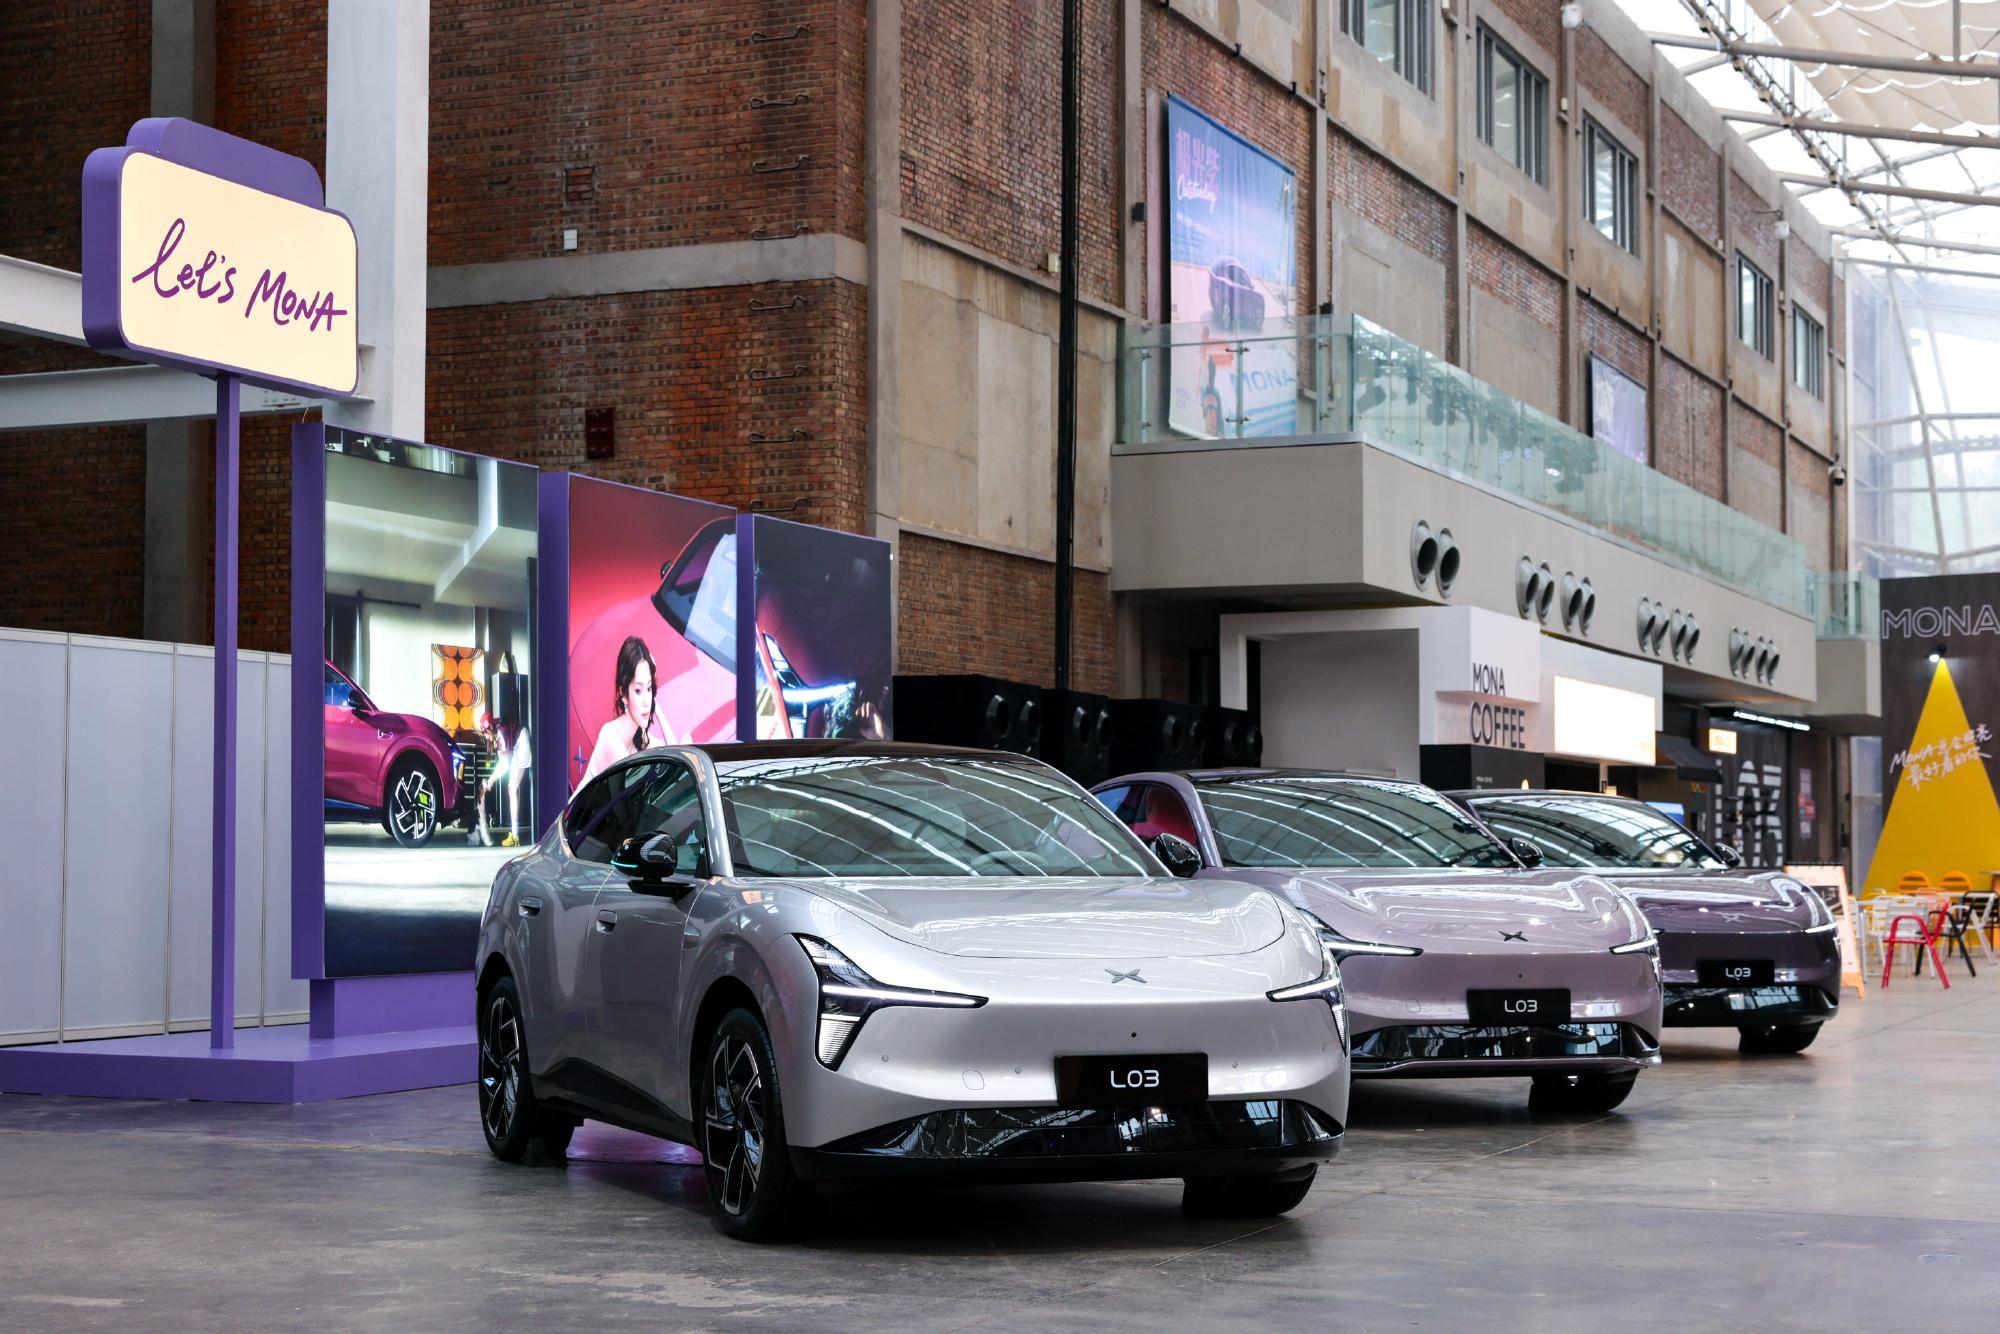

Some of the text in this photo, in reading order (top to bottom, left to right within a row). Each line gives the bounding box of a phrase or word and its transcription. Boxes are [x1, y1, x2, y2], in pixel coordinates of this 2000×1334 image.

[244, 269, 348, 332] MONA
[1881, 604, 2000, 640] MONA
[1472, 661, 1506, 697] MONA
[1470, 701, 1525, 749] COFFEE
[1724, 966, 1752, 980] L03
[1503, 999, 1539, 1013] L03
[1110, 1069, 1160, 1088] L03
